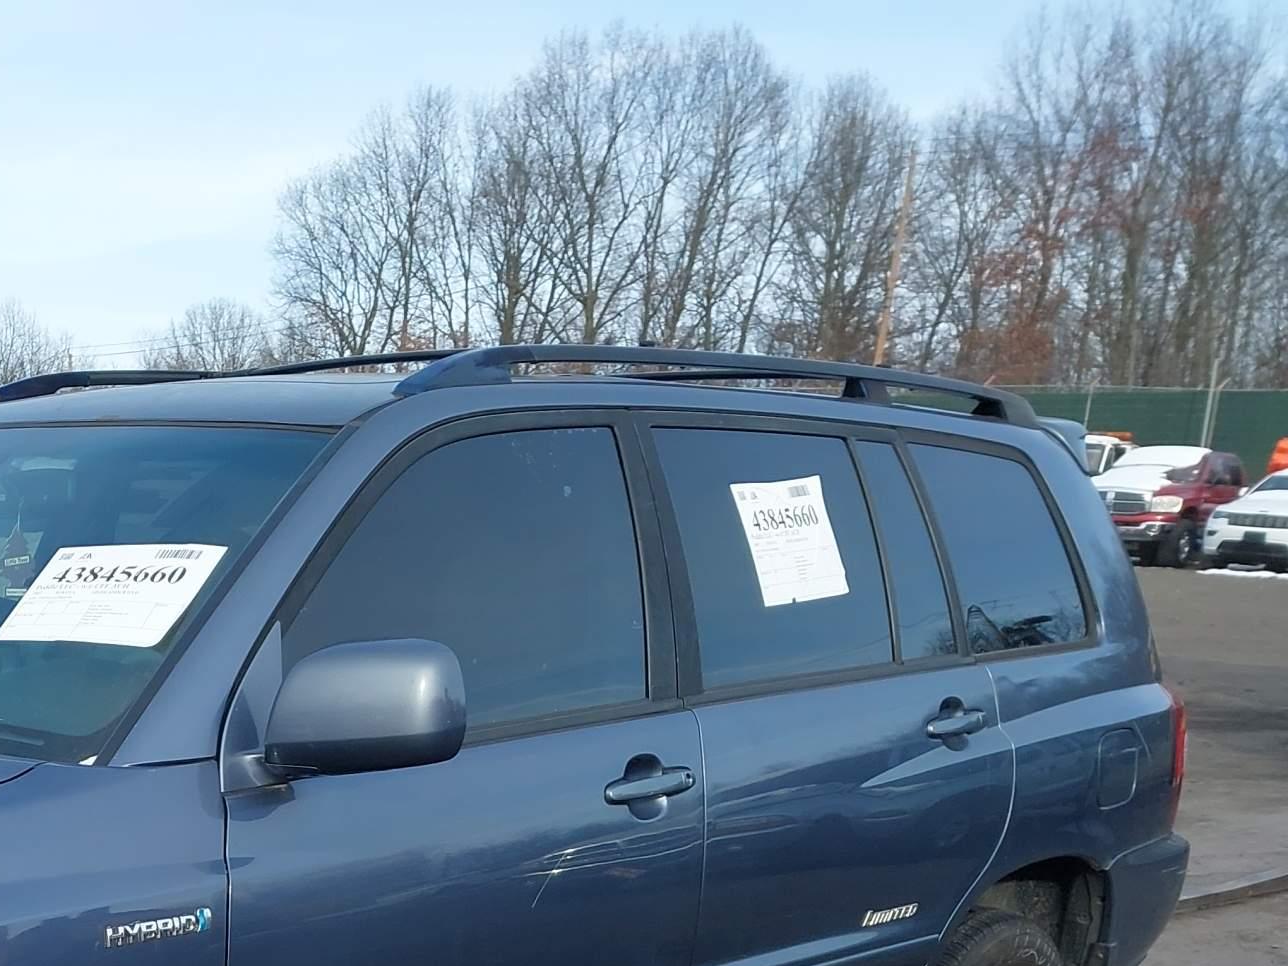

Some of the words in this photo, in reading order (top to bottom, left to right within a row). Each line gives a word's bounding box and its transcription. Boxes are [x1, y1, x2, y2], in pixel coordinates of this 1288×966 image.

[753, 504, 819, 531] 43845660
[52, 564, 187, 585] 43845660
[104, 914, 200, 948] HYBRID
